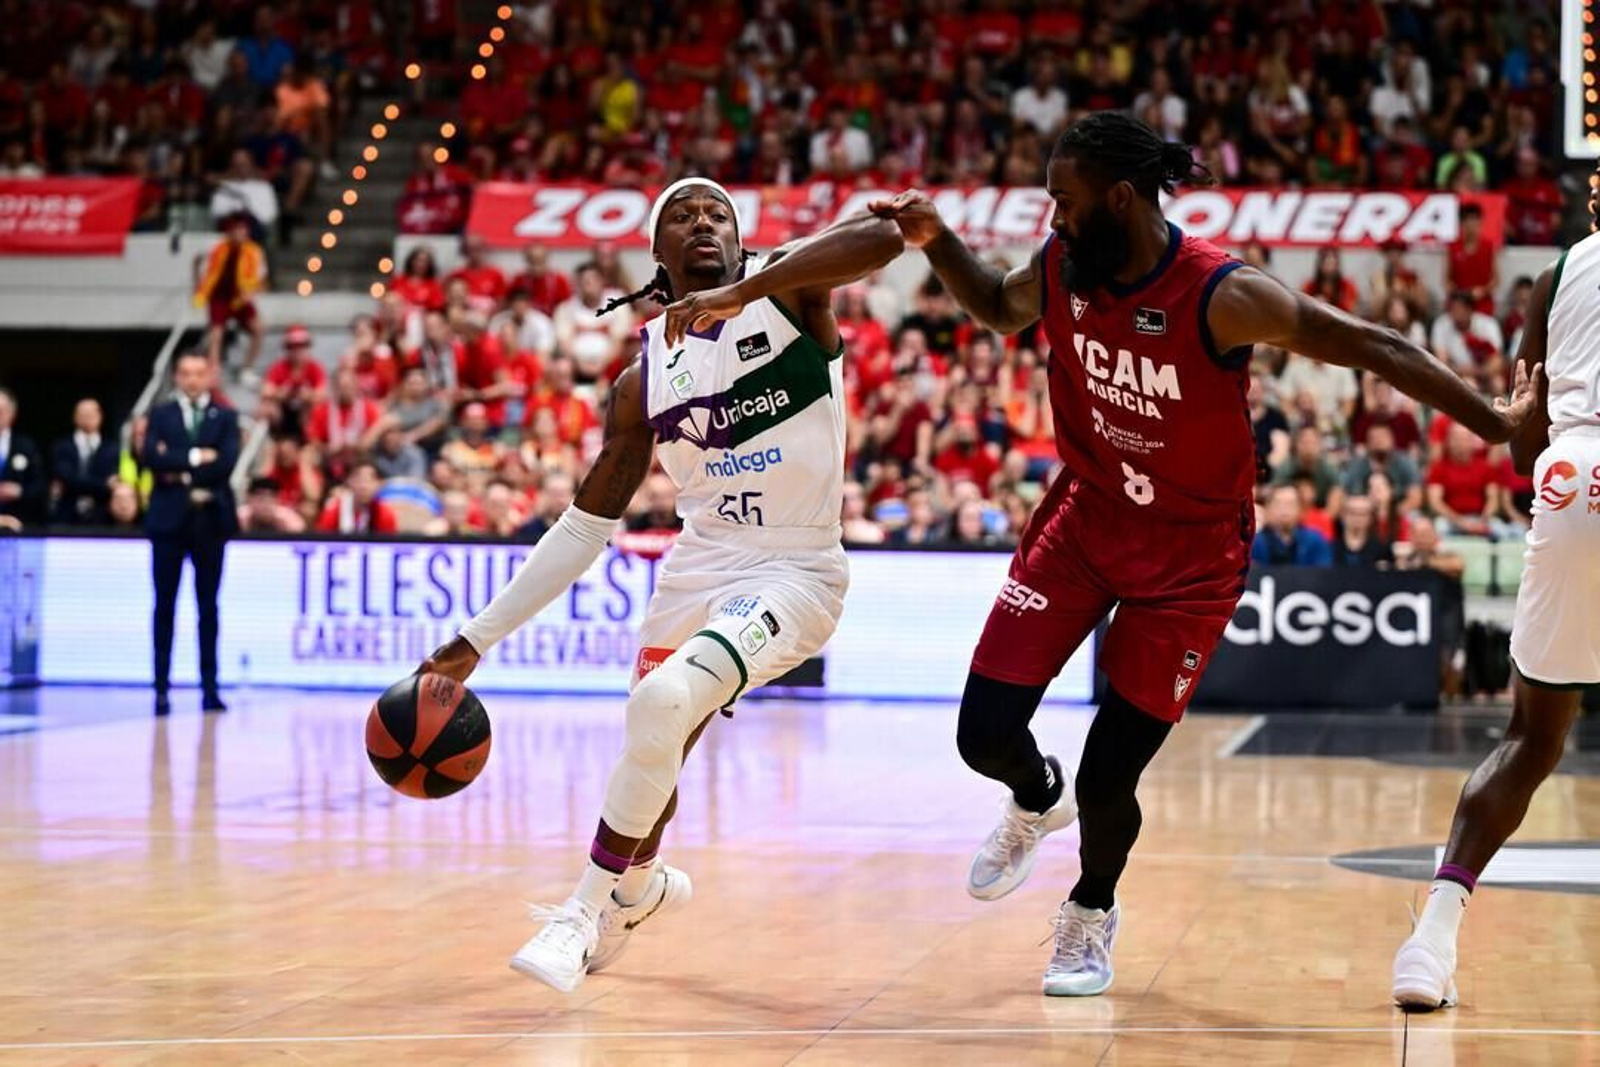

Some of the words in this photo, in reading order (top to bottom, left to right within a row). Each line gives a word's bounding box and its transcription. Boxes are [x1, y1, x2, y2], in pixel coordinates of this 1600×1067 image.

[832, 186, 1462, 246] MEONERA
[711, 387, 791, 430] Unicaja
[1086, 377, 1163, 420] MURCIA
[717, 491, 763, 527] 55
[293, 546, 657, 621] TELESUES
[1224, 575, 1431, 646] desa
[291, 622, 462, 662] CARRETIL
[498, 625, 637, 666] ELEVADO
